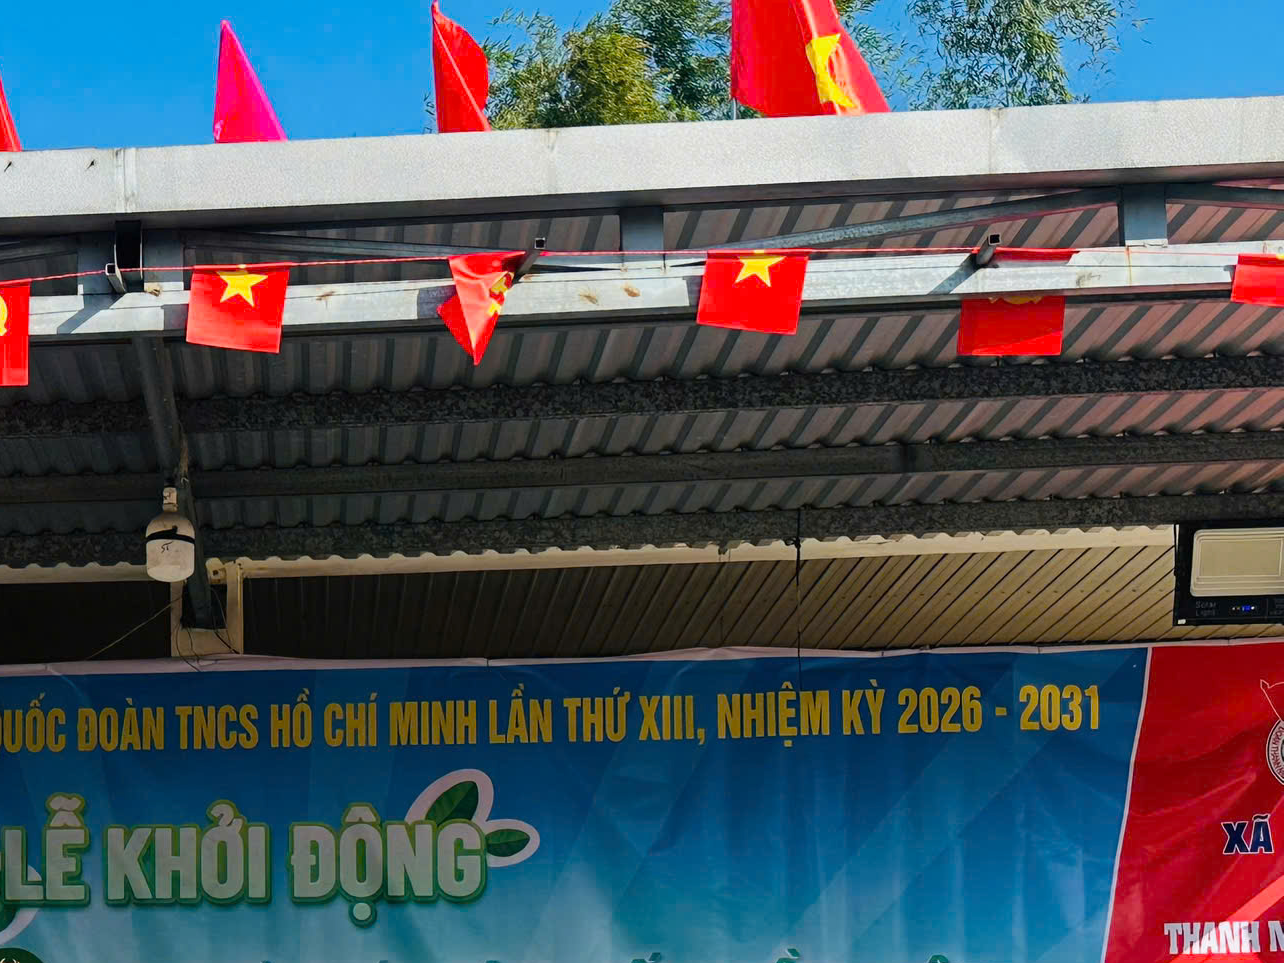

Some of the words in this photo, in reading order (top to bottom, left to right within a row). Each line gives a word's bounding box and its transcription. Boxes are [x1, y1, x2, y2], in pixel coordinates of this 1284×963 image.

[76, 697, 165, 751] ĐOÀN
[175, 704, 259, 750] TNCS
[270, 687, 314, 748] HỒ
[323, 692, 378, 747] CHÍ
[389, 700, 478, 746] MINH
[488, 683, 553, 744] LẦN
[562, 686, 631, 742] THỨ
[638, 695, 706, 745] XIII,
[716, 681, 831, 747] NHIỆM
[841, 678, 886, 736] KỲ
[897, 685, 983, 734] 2026
[1018, 684, 1100, 731] 2031
[2, 793, 90, 905] LỄ
[104, 800, 271, 905] KHỞI
[290, 804, 486, 926] ĐỘNG
[1221, 813, 1274, 855] XÃ
[1164, 920, 1261, 955] THANH
